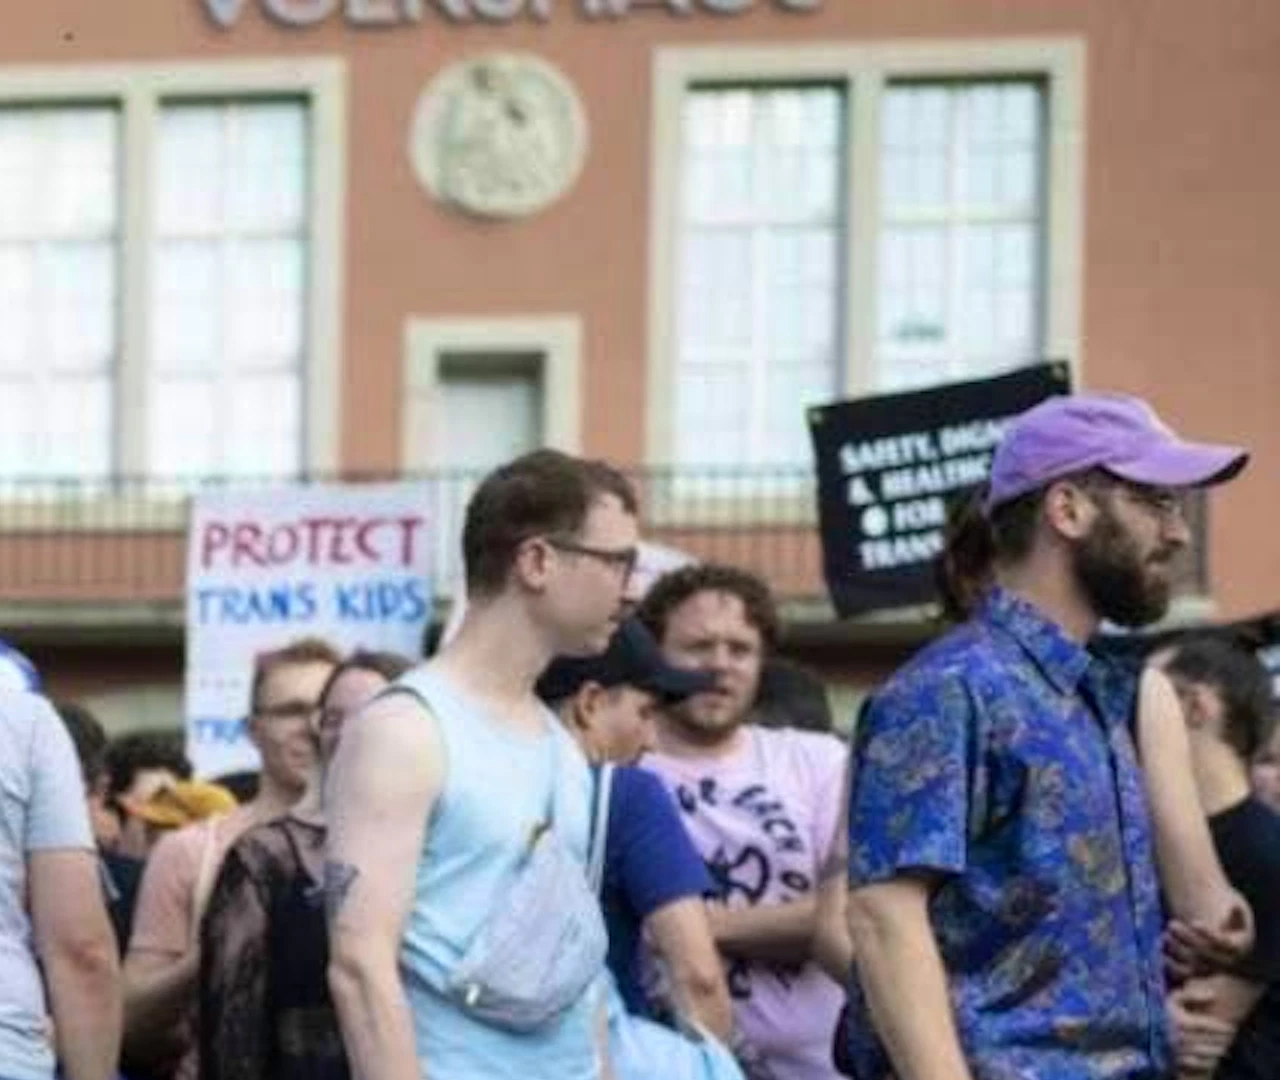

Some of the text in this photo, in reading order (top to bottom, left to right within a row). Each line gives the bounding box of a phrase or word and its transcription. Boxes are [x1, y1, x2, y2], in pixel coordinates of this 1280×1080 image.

[894, 496, 945, 531] FOR
[201, 516, 423, 568] PROTECT
[197, 578, 427, 626] TRANS KIDS
